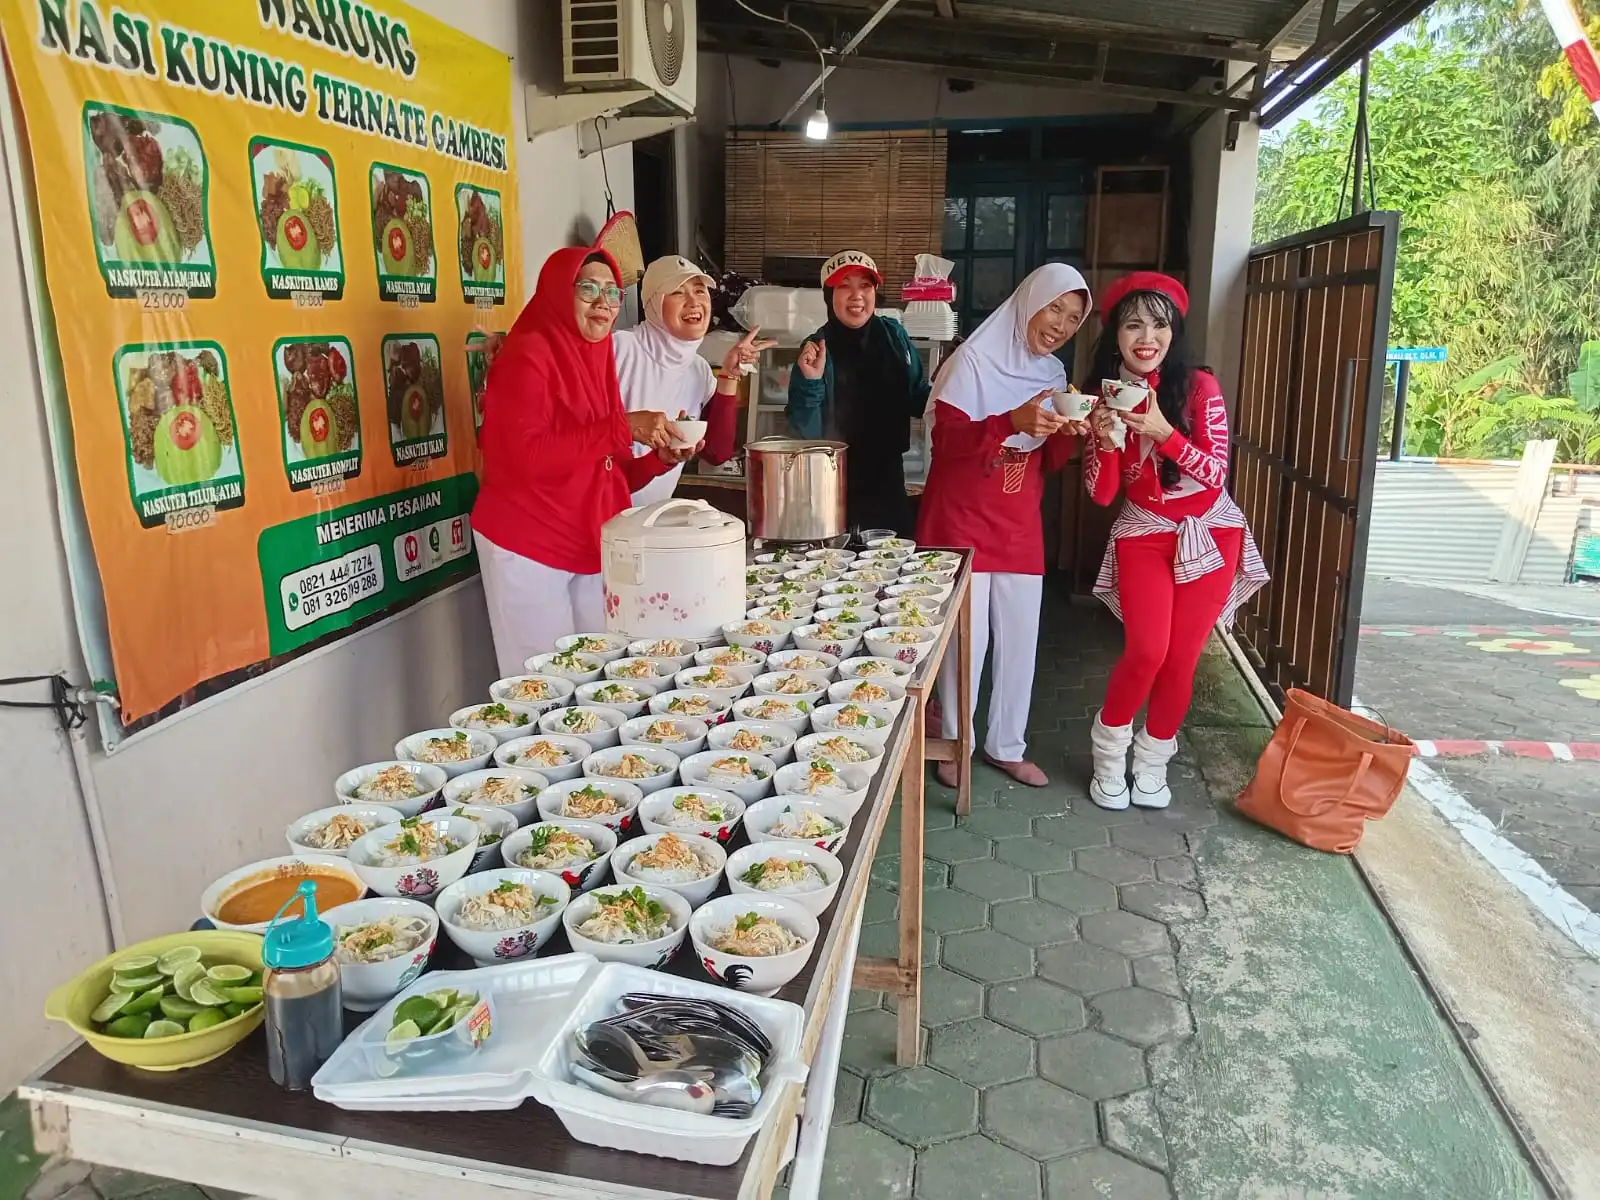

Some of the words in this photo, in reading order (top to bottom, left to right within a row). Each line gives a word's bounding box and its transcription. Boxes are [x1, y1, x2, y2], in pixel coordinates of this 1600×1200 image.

[38, 0, 156, 75] NASI
[161, 27, 307, 112] KUNING
[313, 73, 428, 147] TERNATE
[431, 114, 507, 171] GAMBESI
[107, 269, 161, 287] NASKUTER
[271, 274, 314, 290] NASKUTER
[290, 463, 332, 484] NASKUTER
[331, 457, 359, 475] KOMPLIT
[142, 493, 188, 517] NASKUTER
[316, 507, 386, 544] MENERIMA
[389, 490, 441, 521] PESANAN
[300, 572, 325, 594] 0821
[351, 554, 373, 573] 7274
[303, 595, 321, 616] 081
[325, 585, 348, 607] 326
[362, 573, 378, 591] 288
